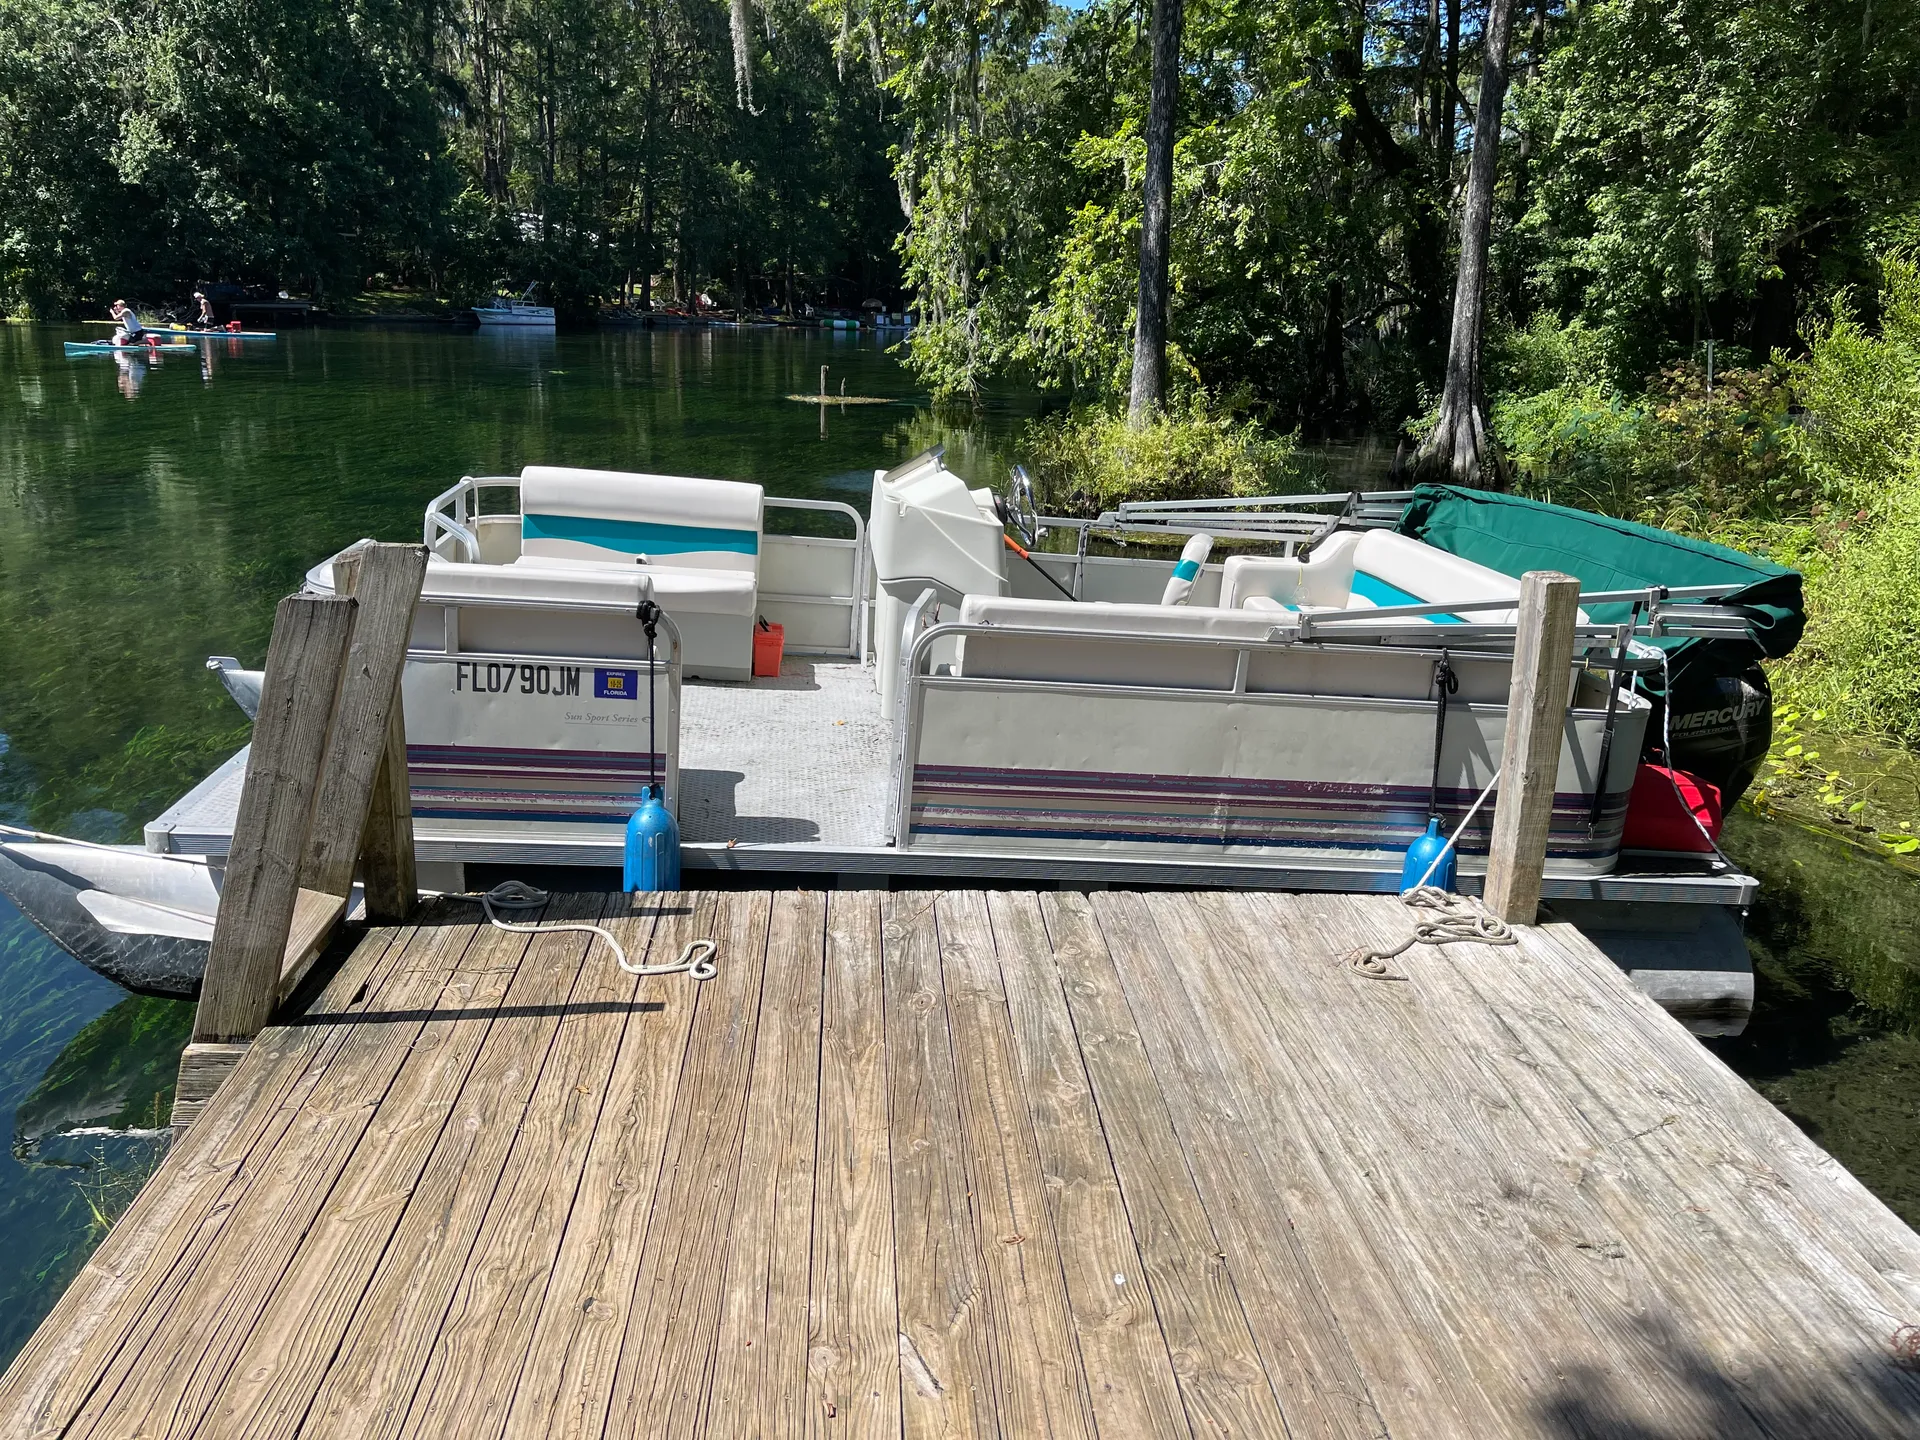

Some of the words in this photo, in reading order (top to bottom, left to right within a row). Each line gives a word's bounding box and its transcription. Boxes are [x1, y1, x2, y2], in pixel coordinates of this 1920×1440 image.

[564, 712, 582, 720] Sun
[585, 713, 609, 723] Sport
[612, 714, 638, 723] Series
[1669, 699, 1766, 731] MERCURY
